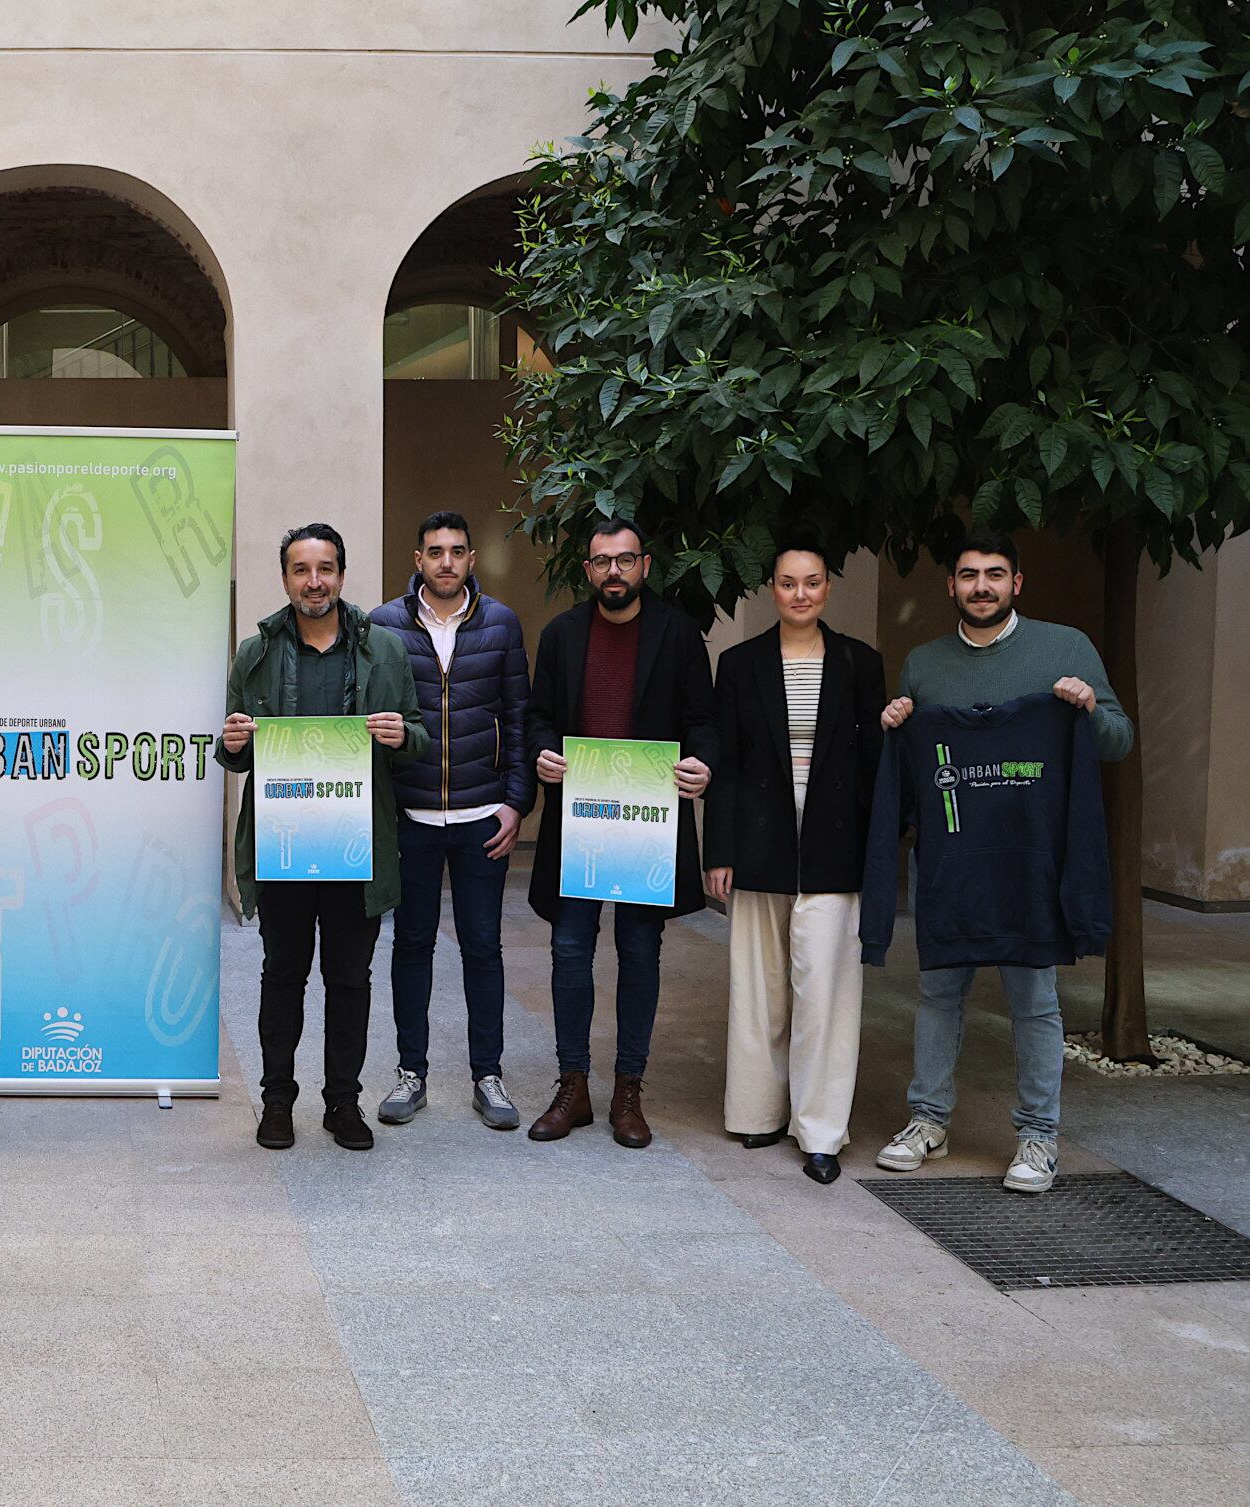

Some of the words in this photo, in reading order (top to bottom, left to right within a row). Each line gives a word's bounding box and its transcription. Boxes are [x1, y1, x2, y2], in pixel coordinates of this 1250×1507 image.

[0, 717, 8, 727] DE
[9, 718, 38, 728] DEPORTE
[39, 718, 67, 728] URBANO
[76, 731, 215, 781] SPORT
[265, 782, 314, 799] URBAN
[316, 781, 363, 798] SPORT
[573, 802, 621, 820] URBAN
[622, 804, 670, 823] SPORT
[21, 1043, 103, 1060] DIPUTACIÓN
[21, 1062, 35, 1072] DE
[38, 1060, 102, 1073] BADAJOZ
